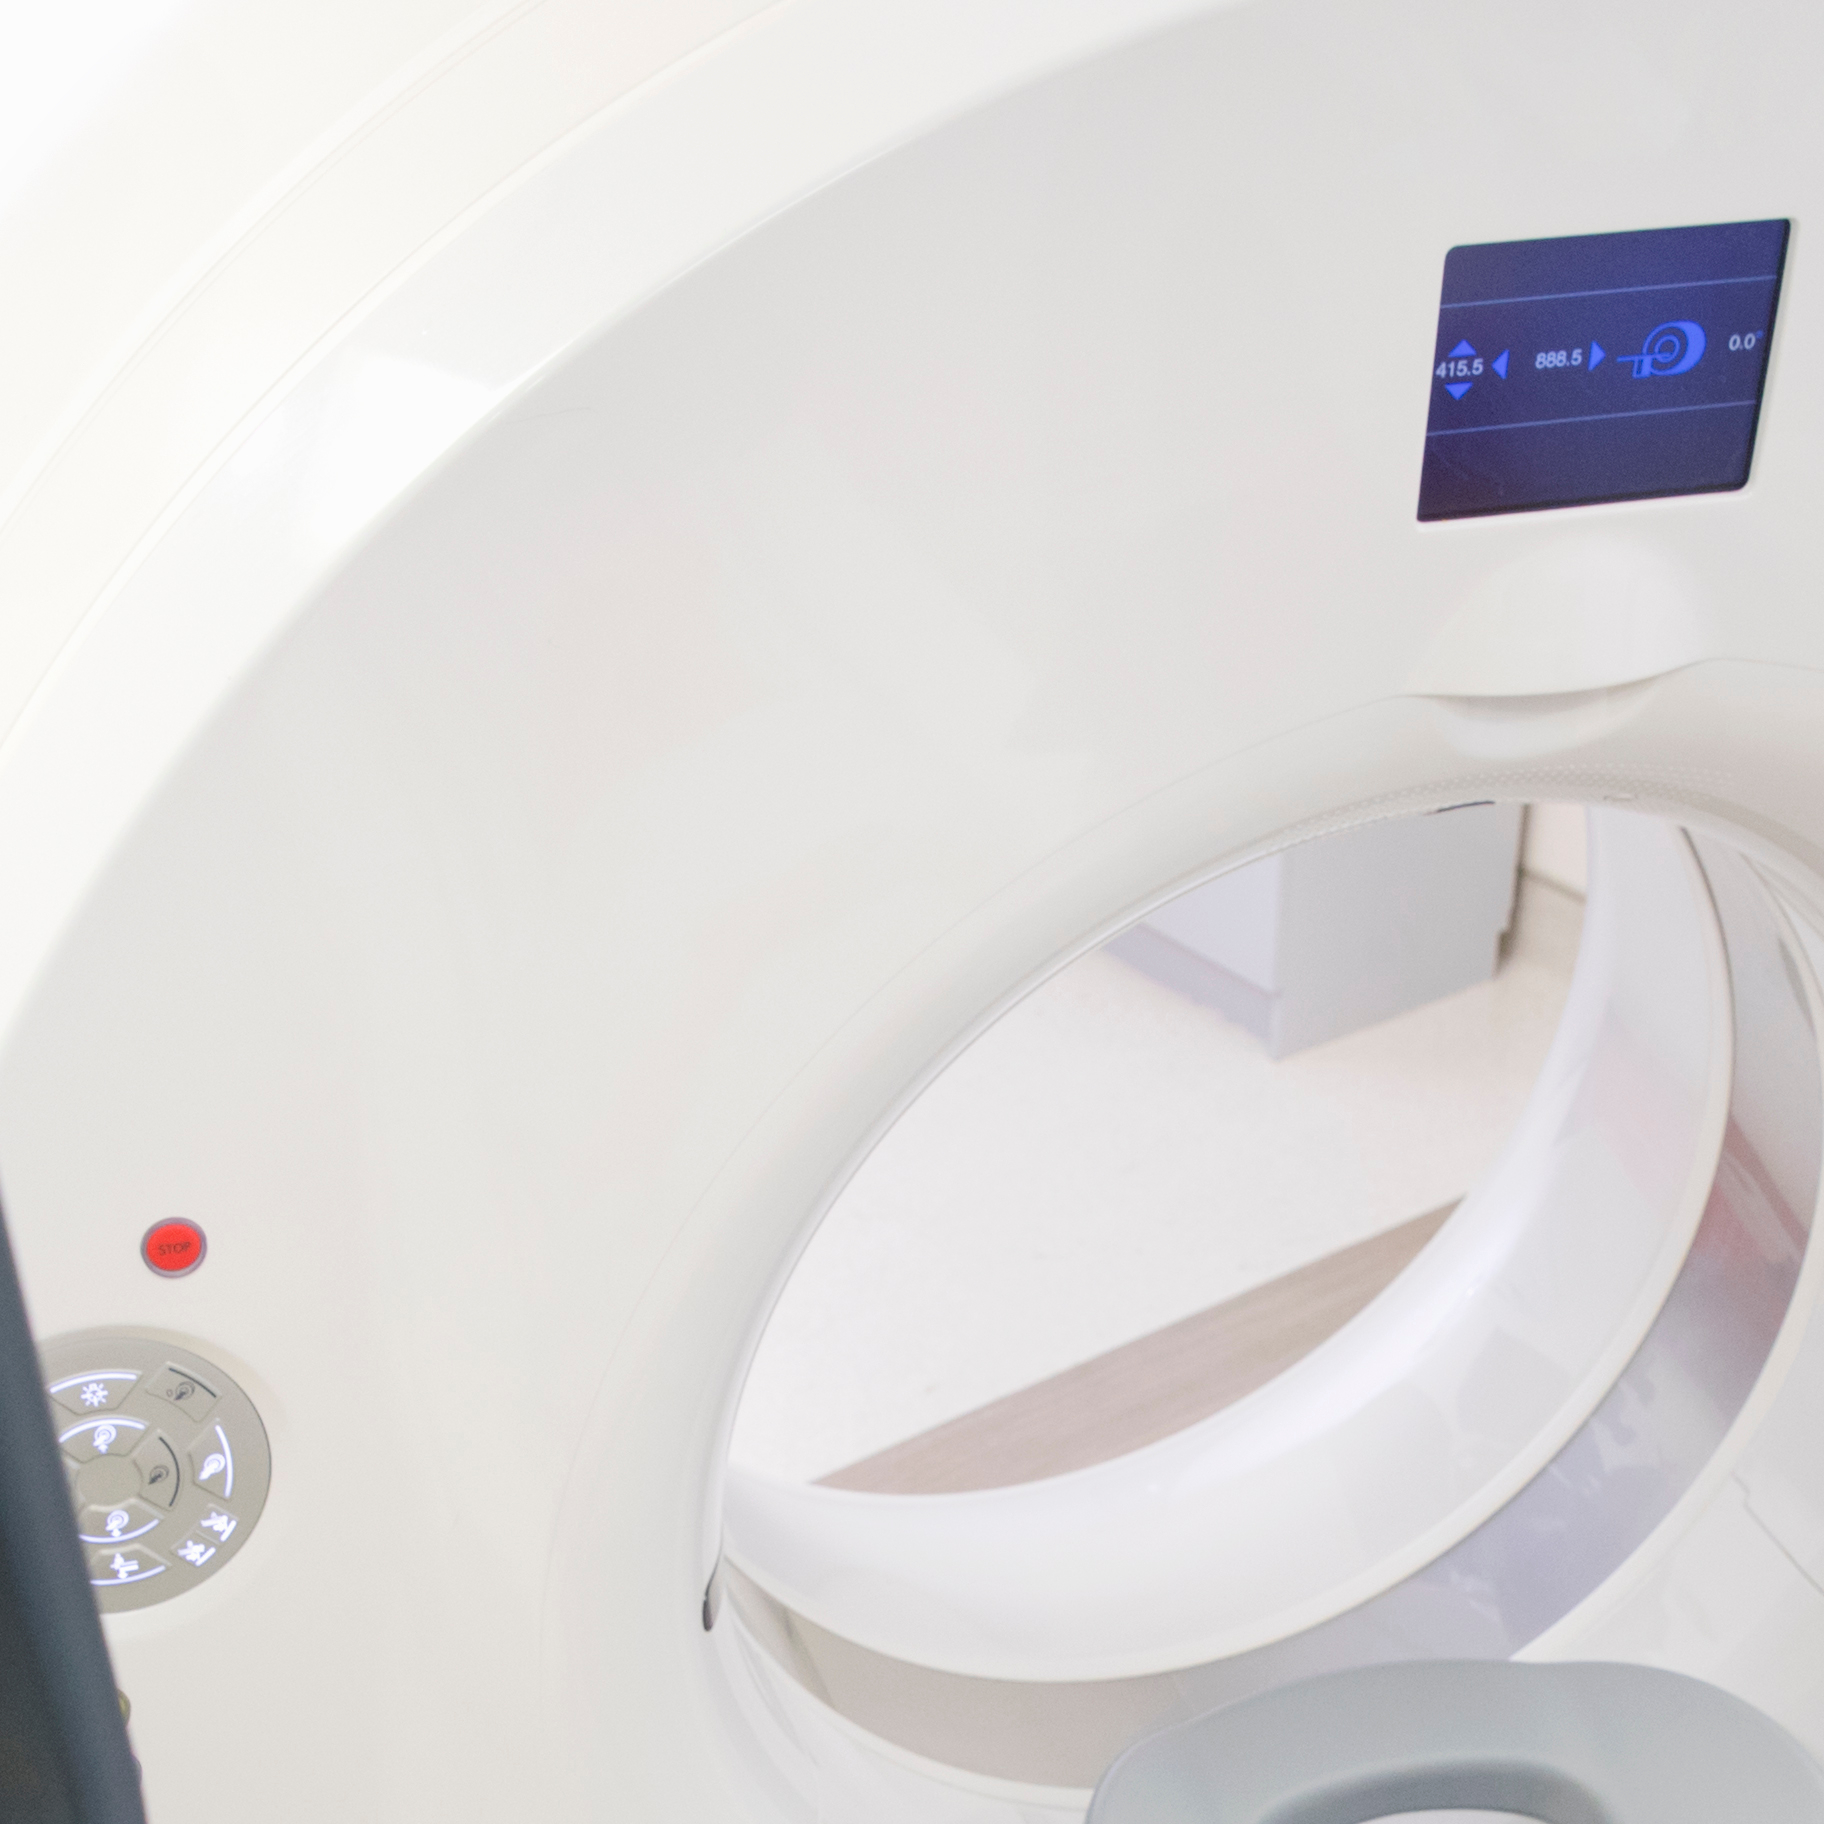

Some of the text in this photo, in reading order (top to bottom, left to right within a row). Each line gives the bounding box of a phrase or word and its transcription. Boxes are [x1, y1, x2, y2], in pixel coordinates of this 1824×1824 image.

[1435, 358, 1484, 378] 415.5
[1535, 348, 1582, 369] 888.5
[158, 1241, 191, 1256] STOP
